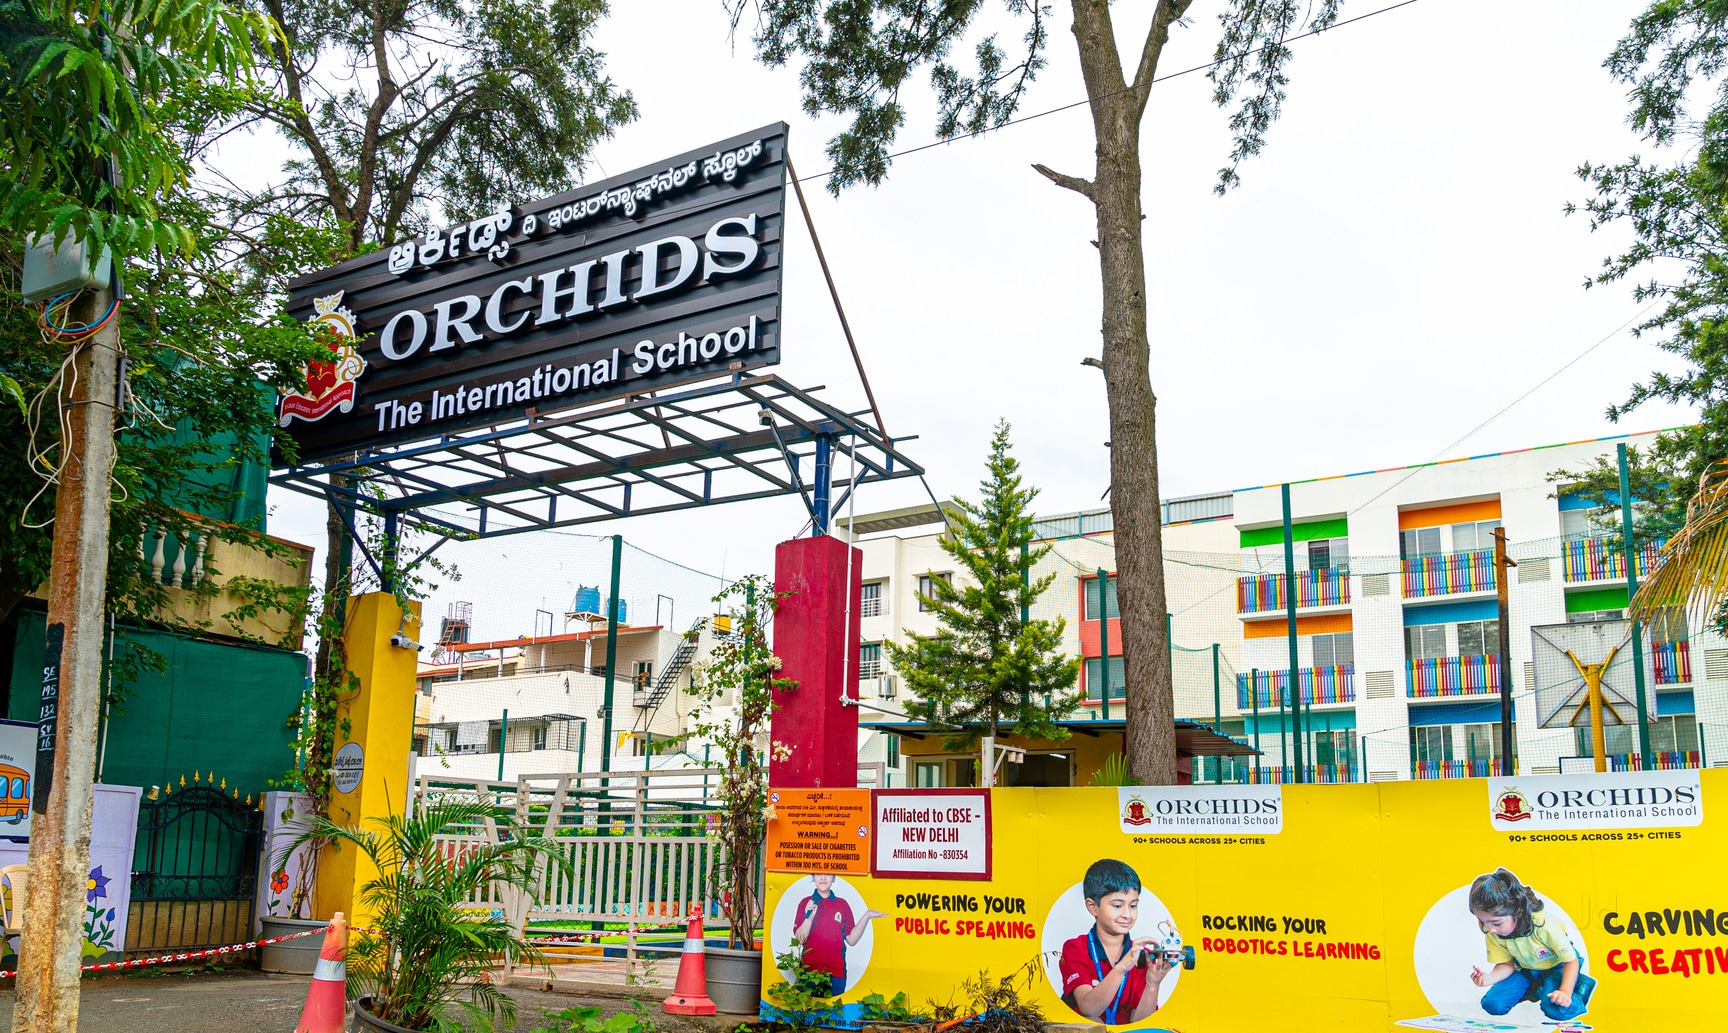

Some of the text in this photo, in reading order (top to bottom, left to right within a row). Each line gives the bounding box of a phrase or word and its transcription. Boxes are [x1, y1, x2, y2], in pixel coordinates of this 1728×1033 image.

[522, 214, 537, 235] ದಿ
[702, 138, 762, 182] ಸ್ಕೂಲ್
[380, 213, 759, 361] ORCHIDS
[375, 315, 758, 432] The International School
[40, 703, 55, 719] 132
[41, 736, 51, 748] 16
[1536, 786, 1696, 808] ORCHIDS
[1156, 798, 1278, 815] ORCHIDS
[1538, 810, 1560, 820] The
[1564, 807, 1648, 820] International
[1651, 806, 1698, 817] School
[882, 807, 930, 823] Affiliated
[932, 808, 944, 823] to
[946, 808, 972, 823] CBSE
[1156, 816, 1173, 825] The
[1176, 816, 1241, 825] International
[1243, 815, 1279, 825] School
[902, 827, 959, 843] NEW DELHI
[1508, 831, 1682, 842] 90+ SCHOOLS ACROSS 25+ CITIES
[780, 842, 804, 850] POSESSION
[804, 842, 811, 850] OR
[812, 842, 822, 850] SALE
[782, 851, 803, 859] TOBACCO
[803, 852, 827, 860] PRODUCTS
[832, 853, 860, 861] PROHIBITED
[892, 849, 927, 859] Affiliation
[928, 850, 938, 860] No
[812, 862, 823, 870] MTS.
[824, 862, 830, 870] OF
[830, 863, 848, 871] SCHOOL
[895, 892, 1026, 914] POWERING YOUR
[895, 916, 1036, 940] PUBLIC SPEAKING
[1202, 915, 1327, 934] ROCKING YOUR
[1202, 937, 1381, 960] ROBOTICS LEARNING
